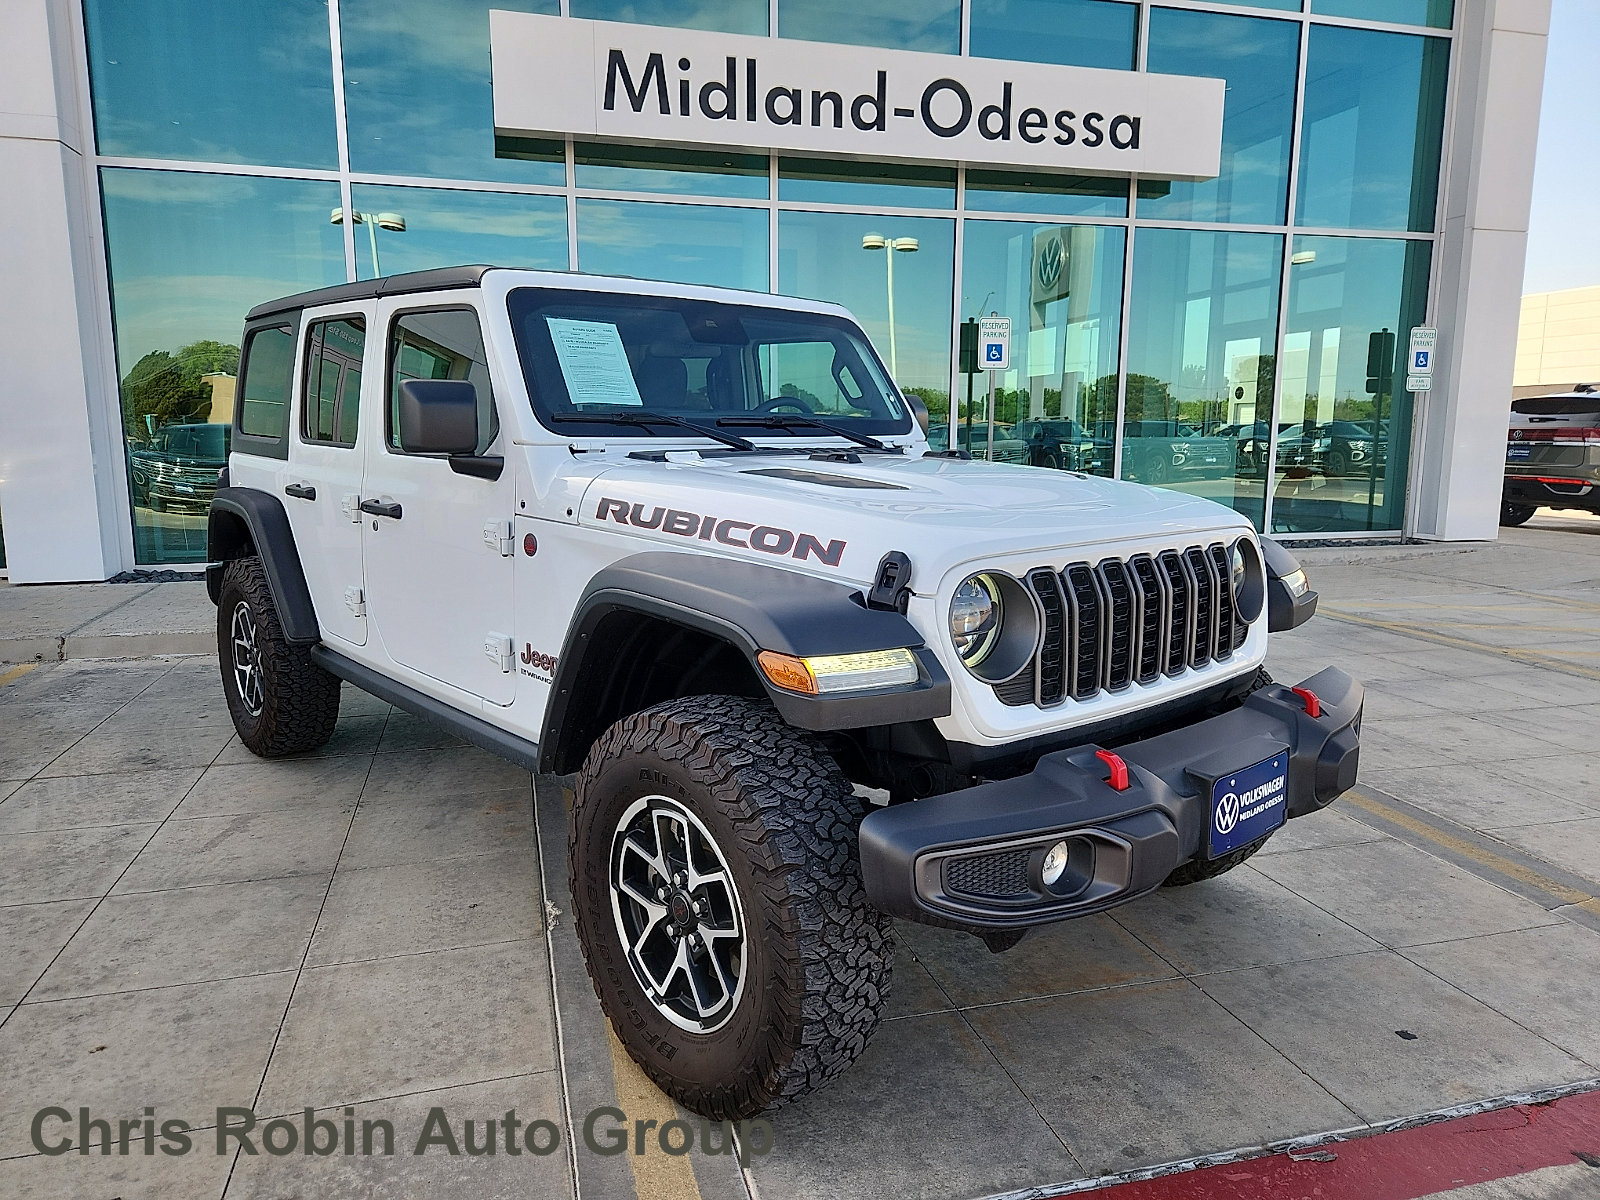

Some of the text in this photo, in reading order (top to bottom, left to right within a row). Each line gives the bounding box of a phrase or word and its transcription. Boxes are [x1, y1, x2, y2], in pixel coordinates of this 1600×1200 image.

[603, 49, 1141, 150] Midland-Odessa
[982, 322, 1008, 330] RESERVED
[983, 331, 1007, 339] PARKING
[595, 497, 847, 567] RUBICON
[520, 642, 559, 678] Jeep
[527, 670, 552, 684] WRANG
[1215, 775, 1285, 834] VW VOLKSWAGEN
[1240, 794, 1284, 822] MIDLAND ODESSA
